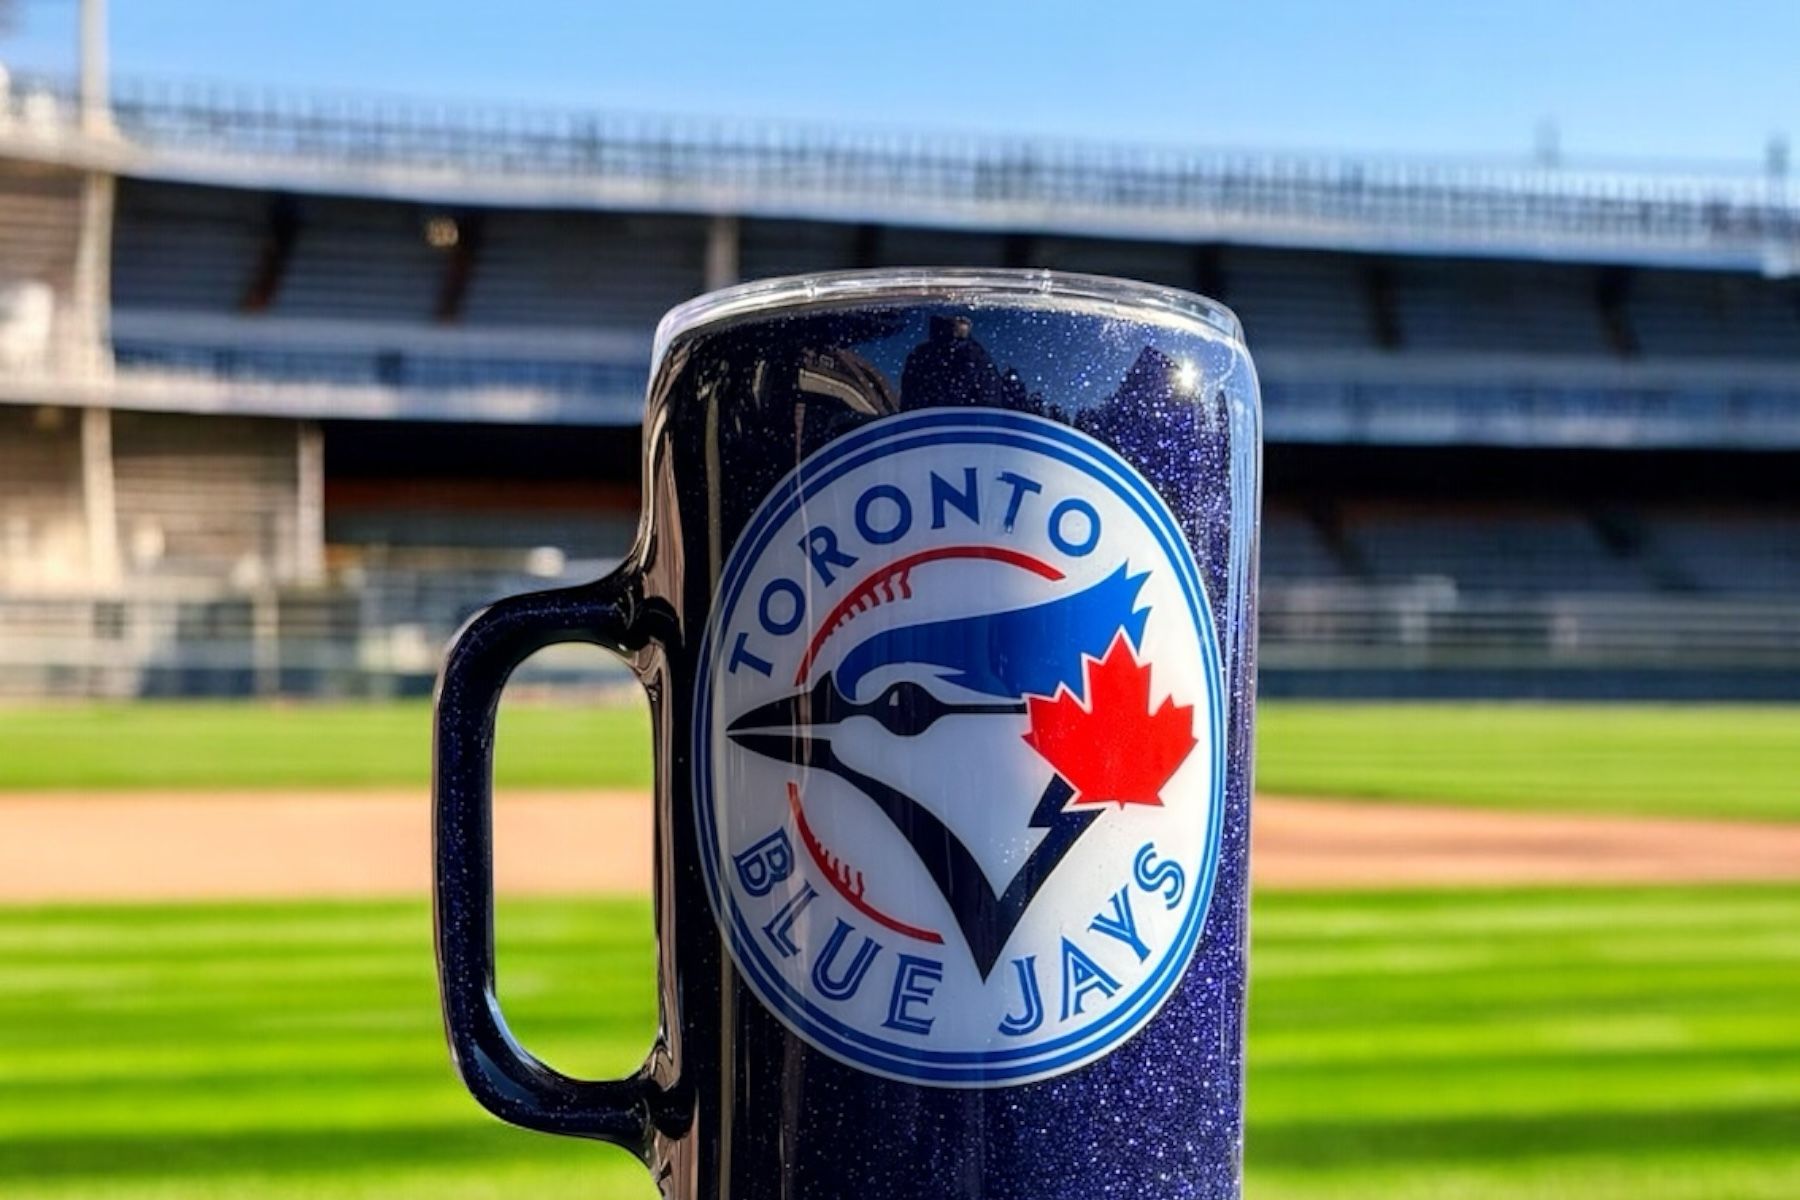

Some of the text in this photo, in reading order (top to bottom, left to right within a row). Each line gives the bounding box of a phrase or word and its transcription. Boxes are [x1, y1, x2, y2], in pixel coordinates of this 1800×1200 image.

[729, 468, 1101, 679] TORONTO
[732, 826, 1185, 1037] BLUE JAYS
